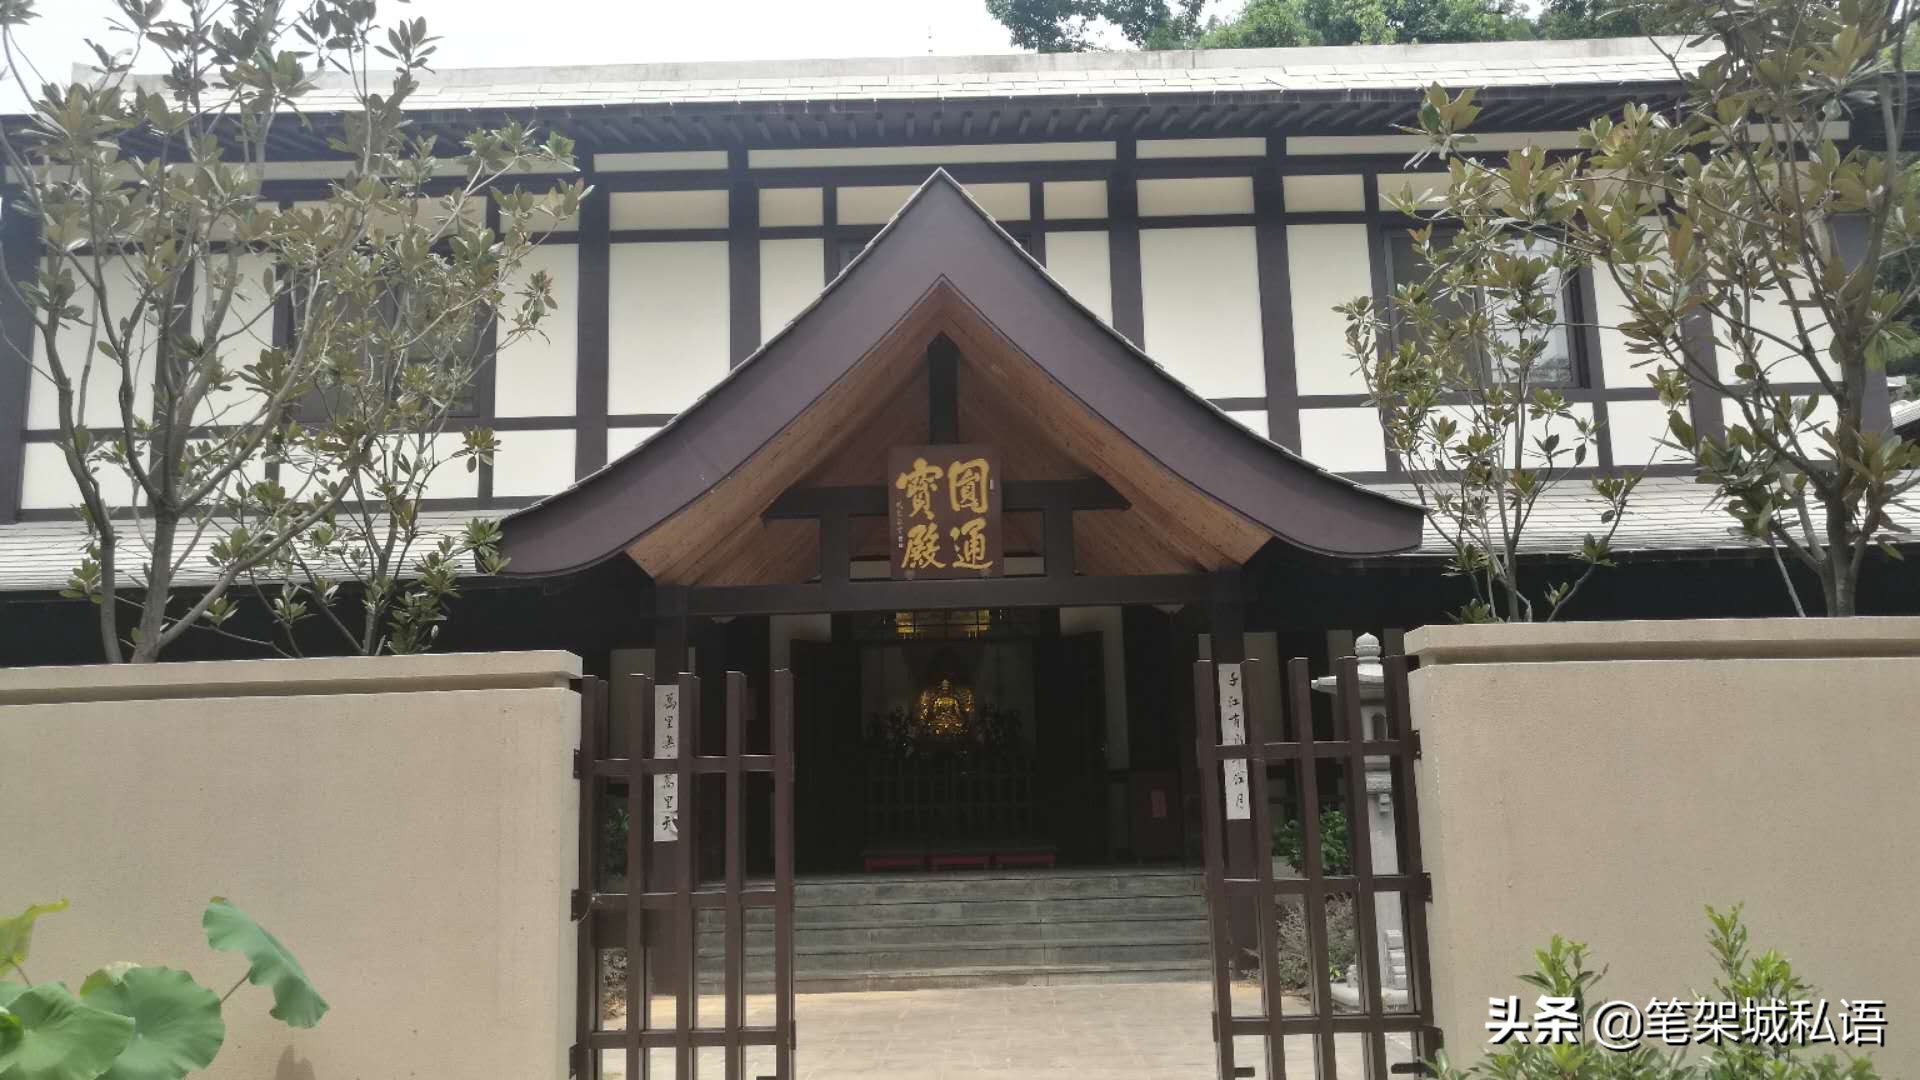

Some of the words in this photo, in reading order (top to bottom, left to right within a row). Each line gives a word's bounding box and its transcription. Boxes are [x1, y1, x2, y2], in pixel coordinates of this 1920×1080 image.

[947, 458, 993, 569] 圓通
[662, 692, 678, 831] 萬里無萬里天
